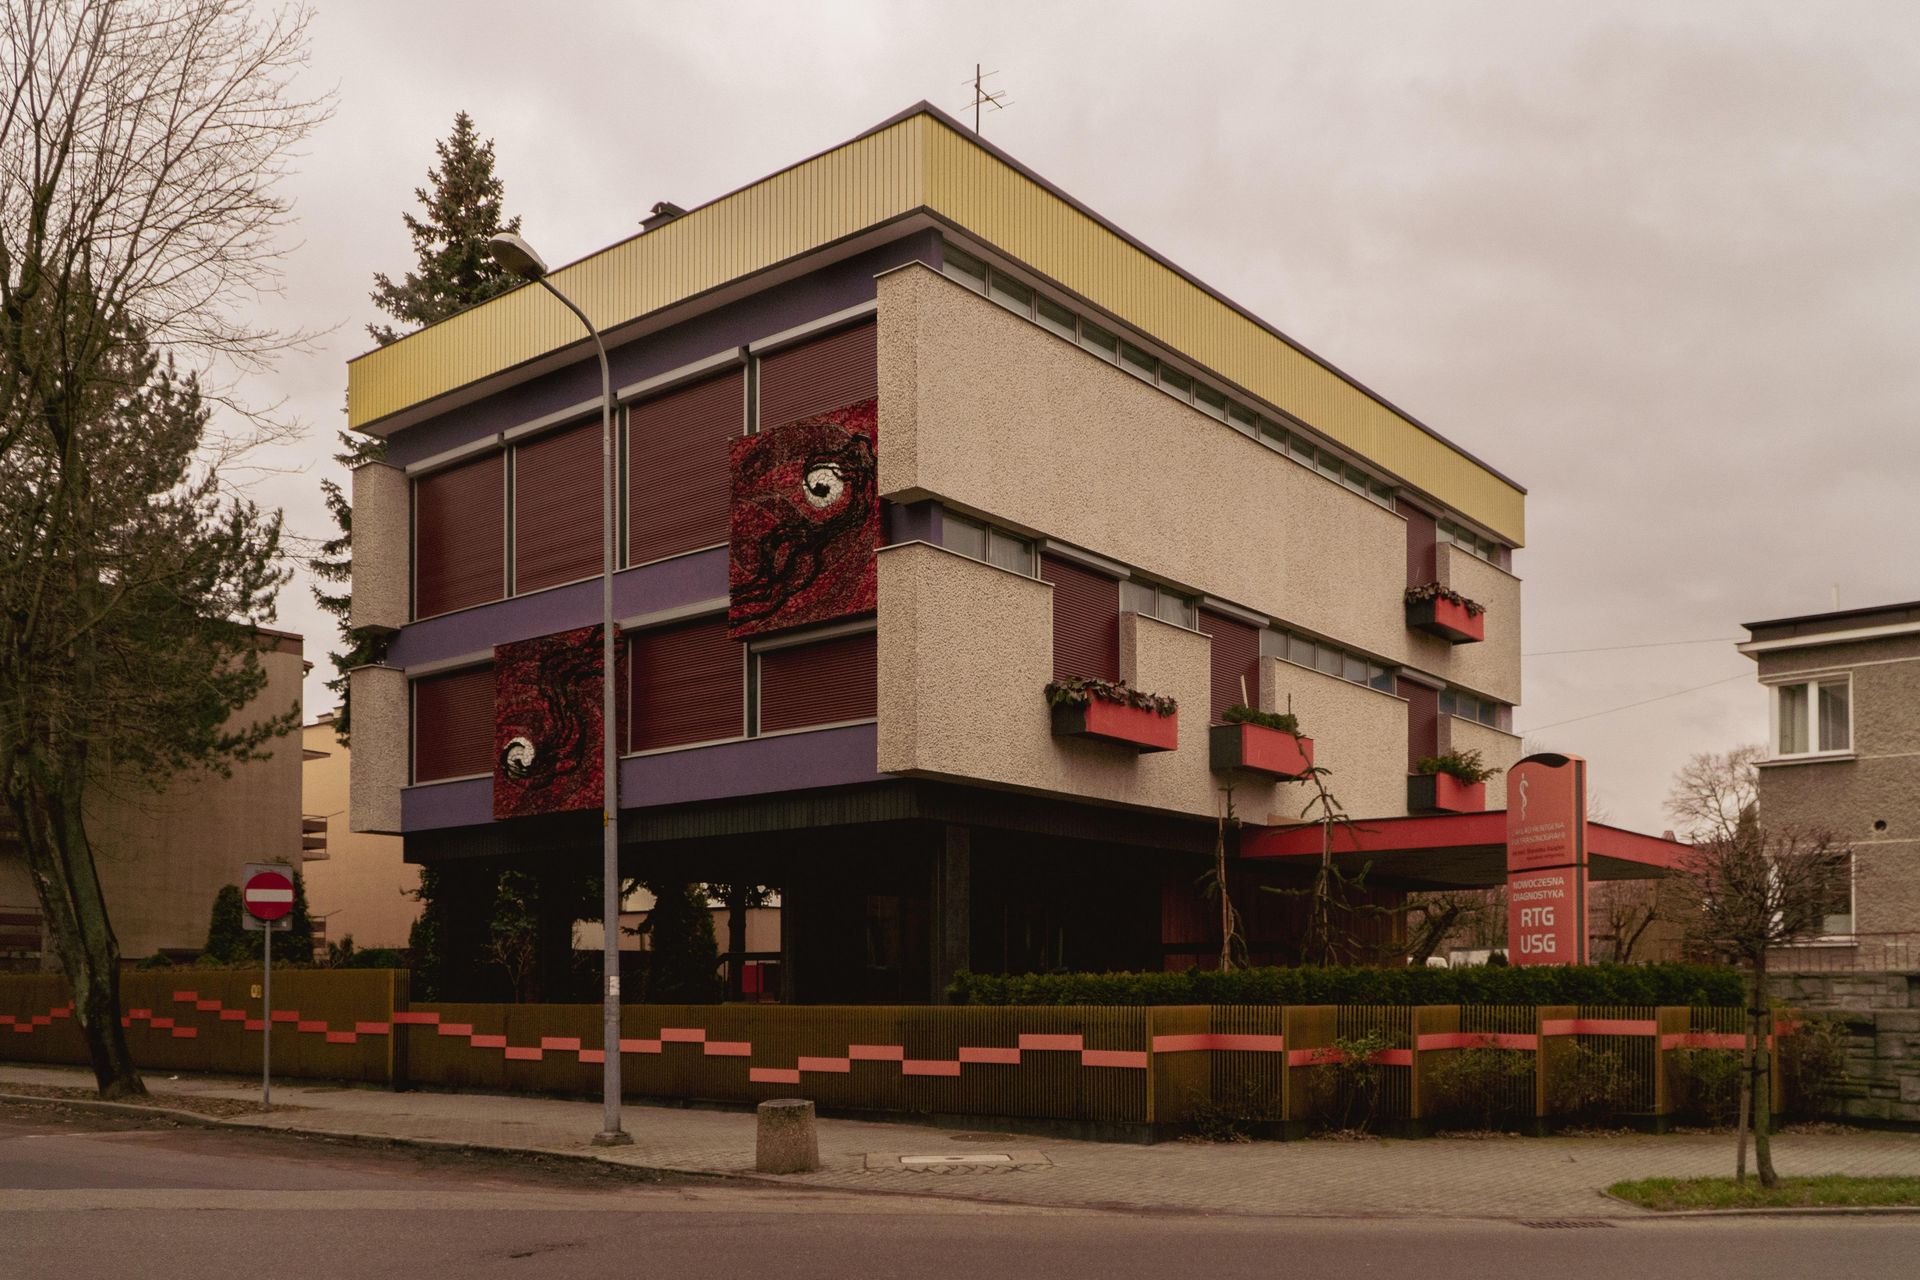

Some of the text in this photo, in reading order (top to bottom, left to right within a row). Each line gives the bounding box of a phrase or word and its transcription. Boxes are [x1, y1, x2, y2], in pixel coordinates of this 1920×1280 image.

[1513, 877, 1564, 889] NOWOCZESNA
[1513, 889, 1564, 901] DIAGNOSTYKA
[1521, 906, 1554, 927] RTG
[1520, 933, 1556, 954] USG
